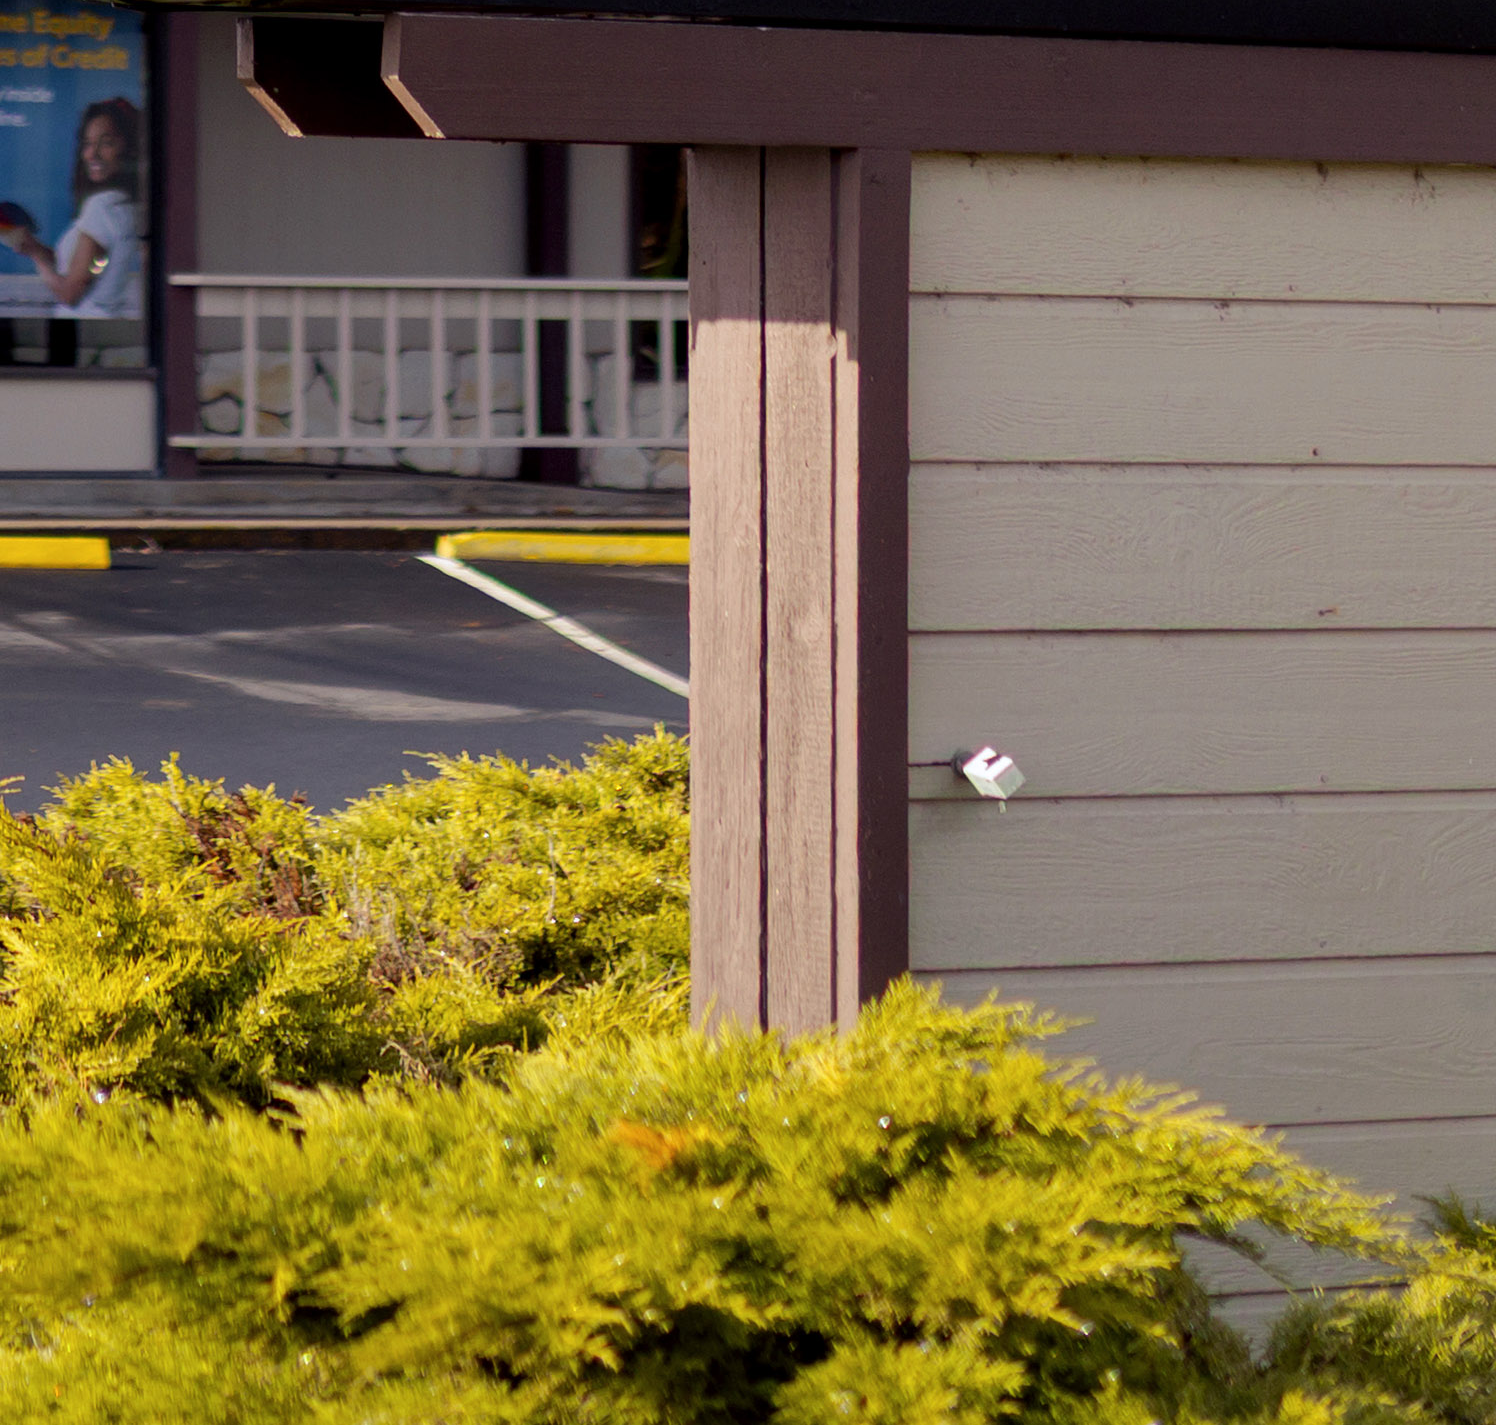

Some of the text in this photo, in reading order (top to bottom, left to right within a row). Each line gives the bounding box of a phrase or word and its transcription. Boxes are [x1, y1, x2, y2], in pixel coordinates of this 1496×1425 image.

[32, 9, 114, 40] Equity
[21, 43, 49, 68] of
[51, 44, 129, 70] Credit
